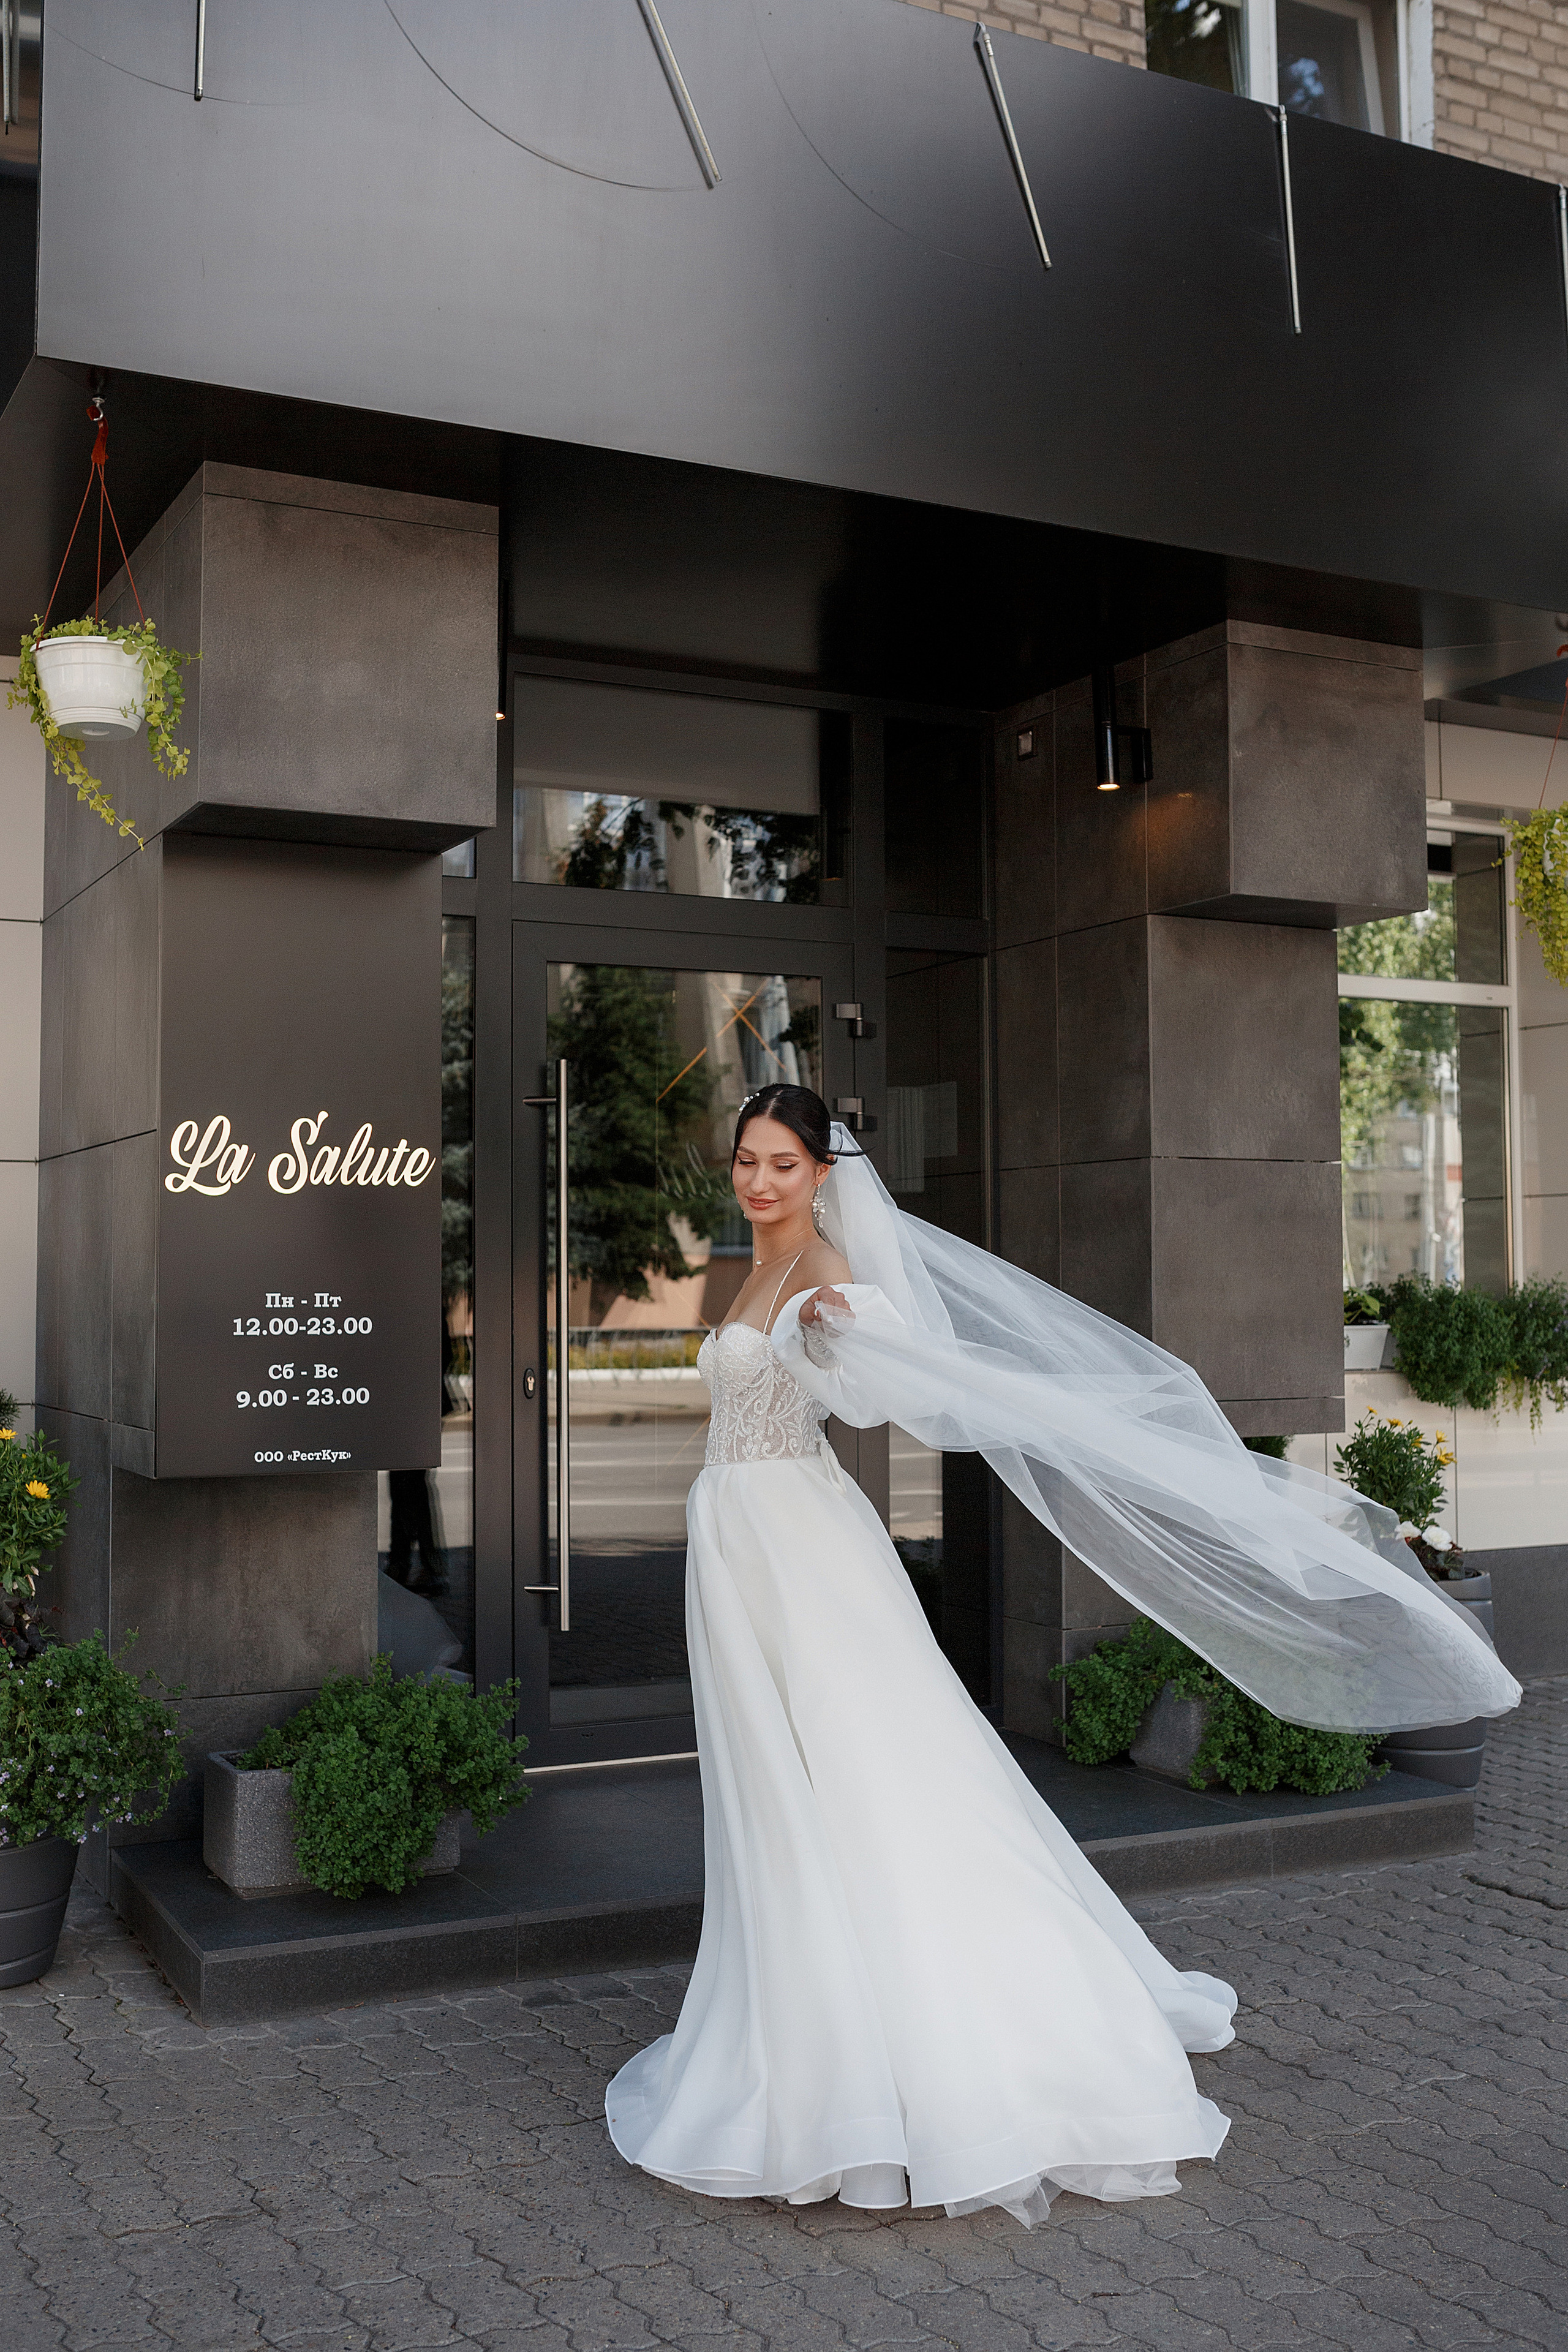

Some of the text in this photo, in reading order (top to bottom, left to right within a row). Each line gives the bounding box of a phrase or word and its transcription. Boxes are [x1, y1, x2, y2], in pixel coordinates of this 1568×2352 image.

[164, 1110, 435, 1196] La Salute
[265, 1292, 295, 1308] Пн
[314, 1292, 342, 1308] Пт
[233, 1317, 373, 1336] 12.00-23.00
[268, 1362, 295, 1380] Сб
[314, 1363, 339, 1379] Вс
[236, 1389, 287, 1409] 9.00
[306, 1387, 370, 1406] 23.00
[254, 1449, 352, 1463] ООО «РестКук»
